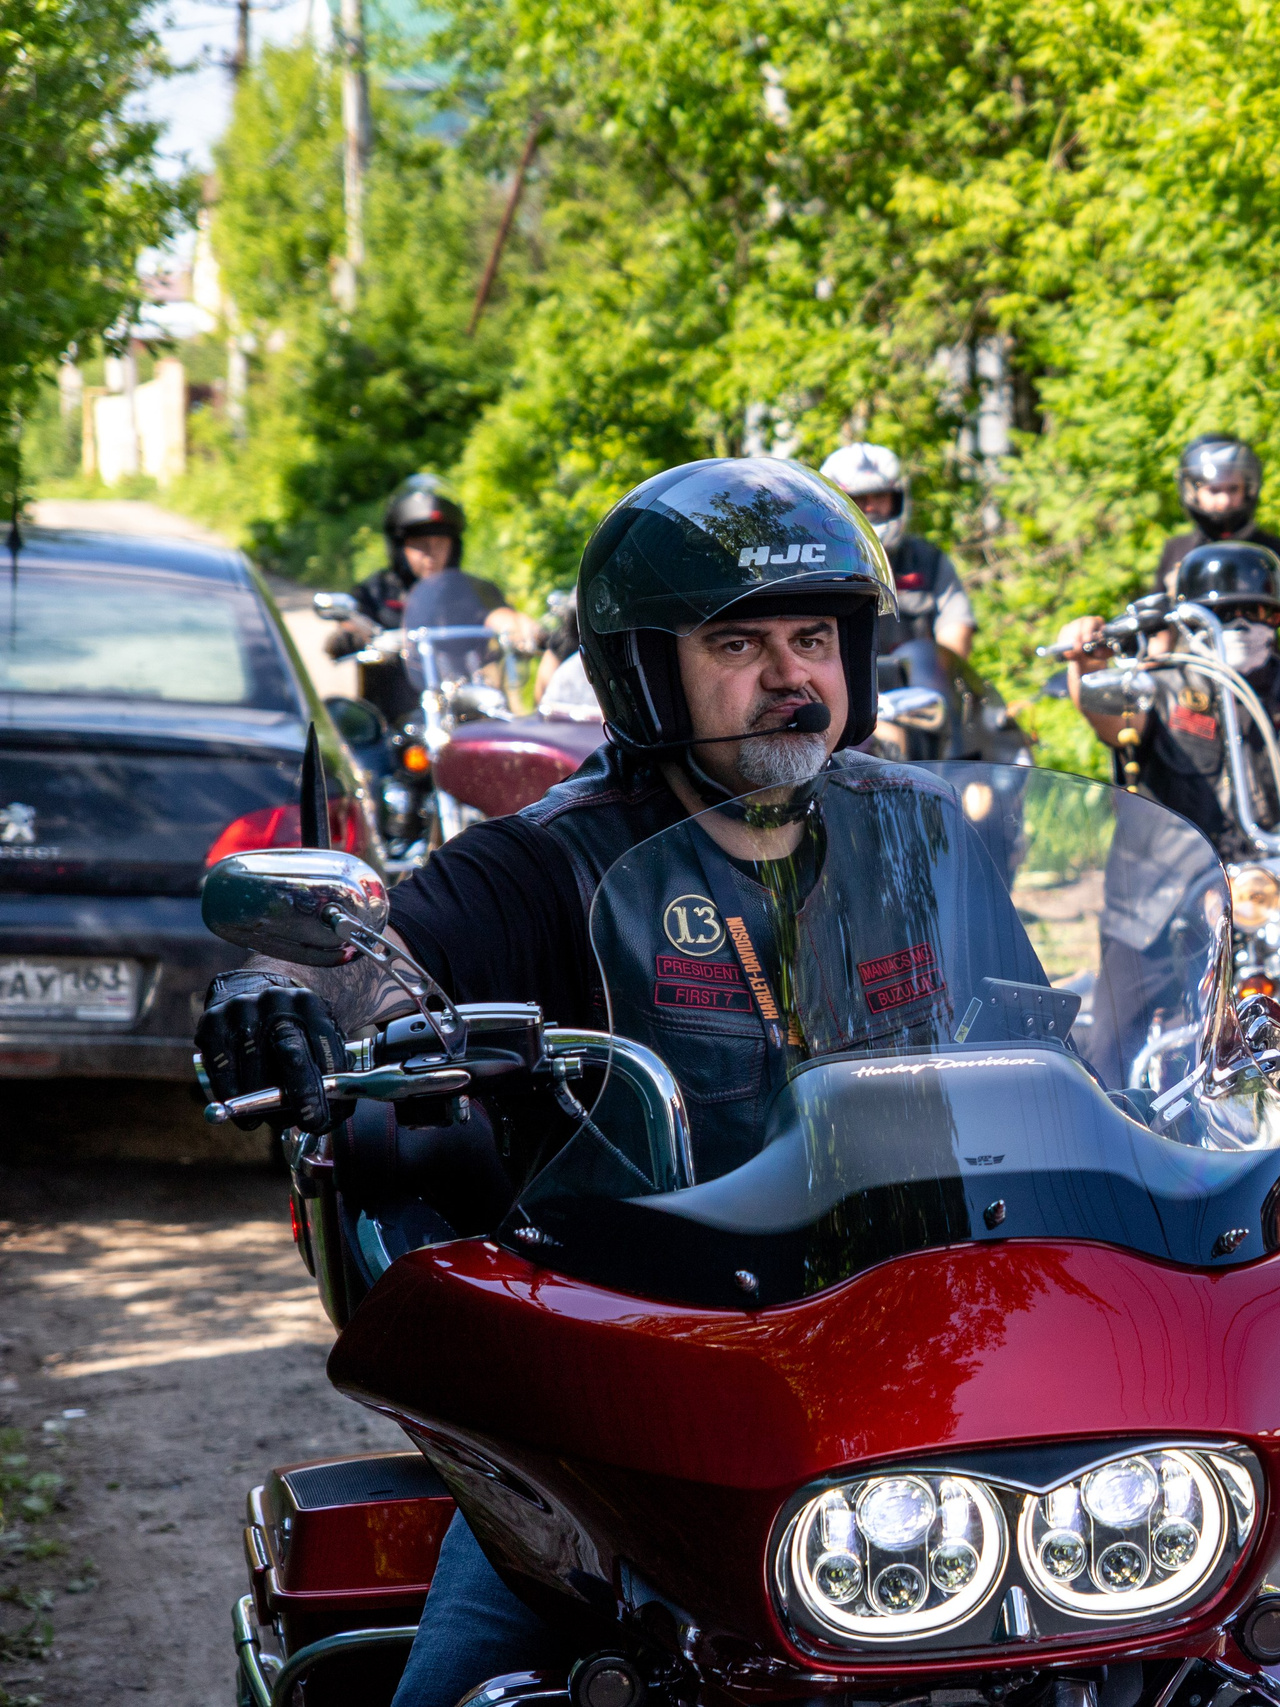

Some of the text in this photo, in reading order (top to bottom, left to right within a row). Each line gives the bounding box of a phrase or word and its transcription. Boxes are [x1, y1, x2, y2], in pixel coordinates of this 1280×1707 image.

[738, 543, 827, 567] HJC
[672, 905, 720, 943] 13
[663, 960, 741, 980] PRESIDENT
[725, 916, 779, 1020] HARLEY-DAVIDSON
[861, 946, 931, 981] MANIACS MC
[675, 988, 734, 1006] FIRST 7
[877, 975, 935, 1007] BUZULUK
[851, 1056, 1047, 1078] Harley-Davidson
